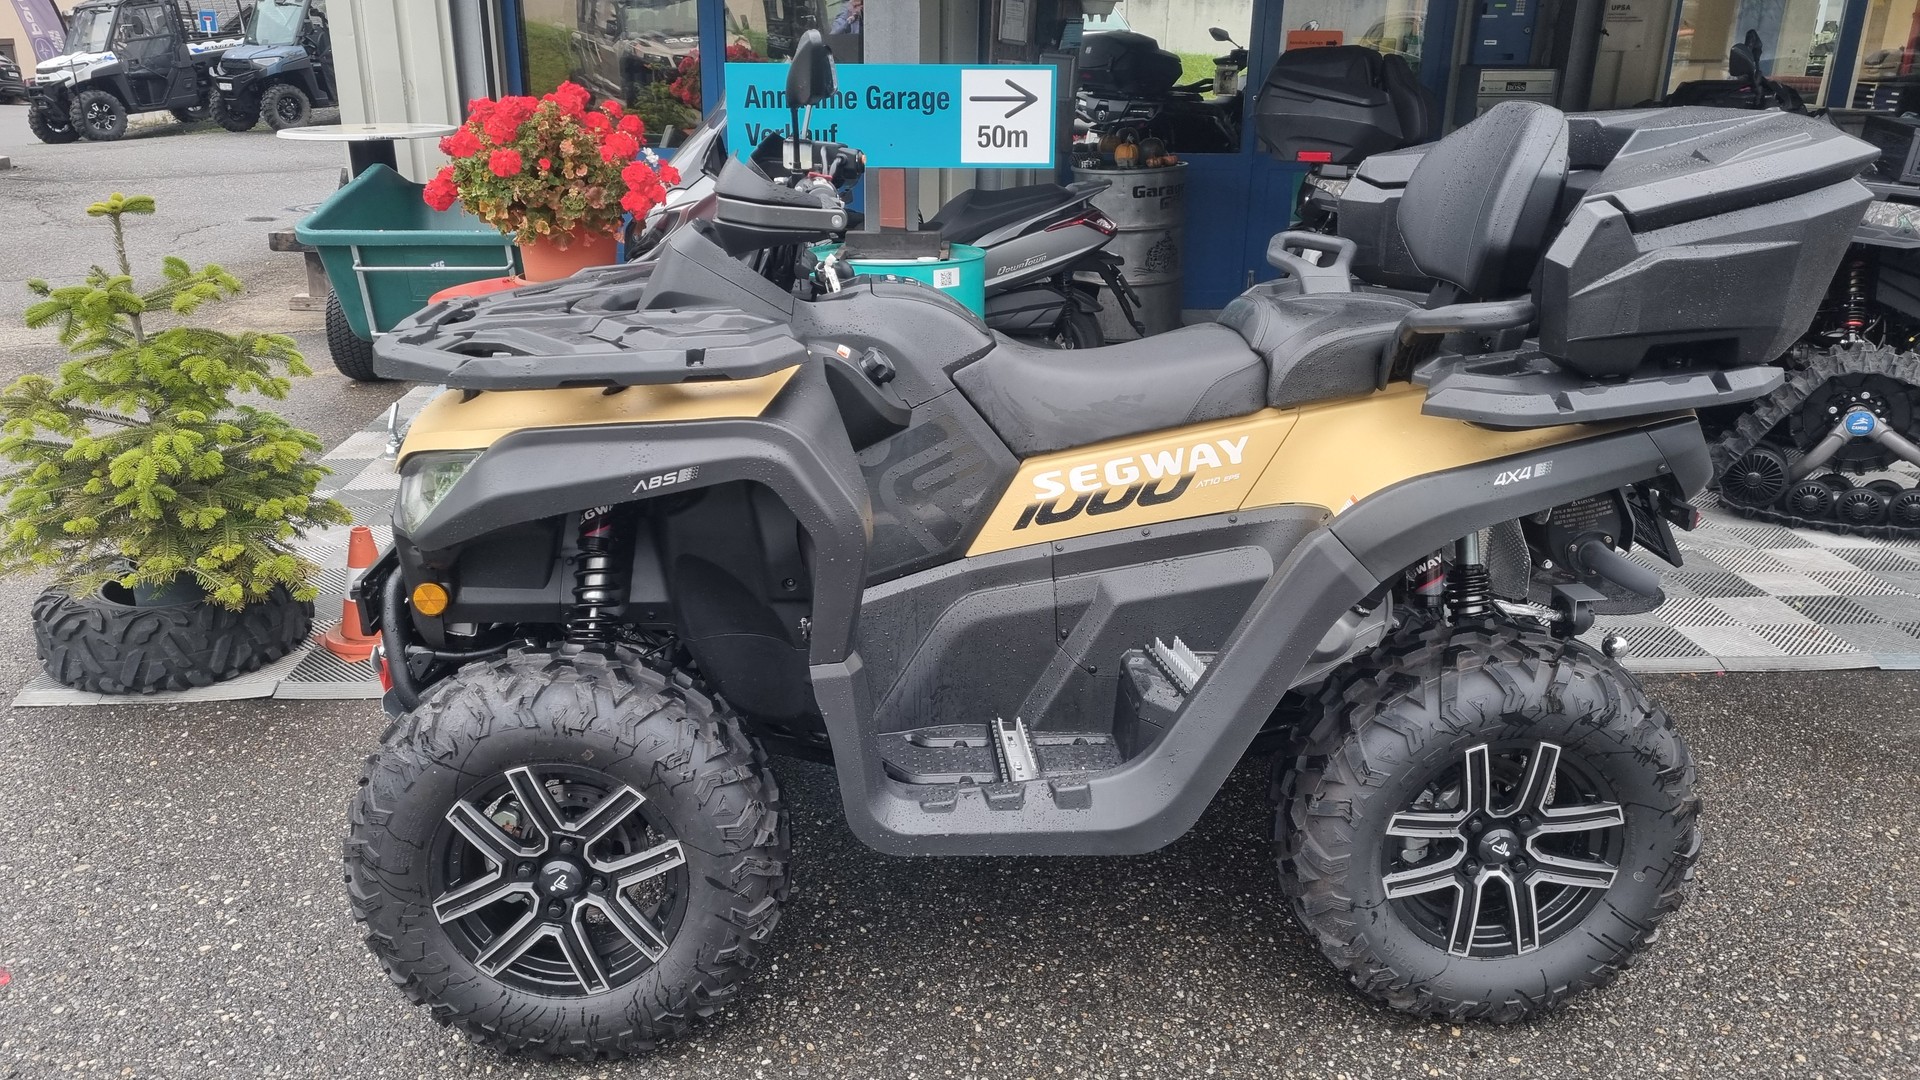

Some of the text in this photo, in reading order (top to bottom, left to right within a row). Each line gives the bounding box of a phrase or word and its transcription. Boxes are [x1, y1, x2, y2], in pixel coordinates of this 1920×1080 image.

[744, 84, 950, 115] Annme Garage
[977, 124, 1028, 148] 50m
[1032, 435, 1249, 500] SEGWAY
[1493, 466, 1532, 486] 4X4
[632, 471, 678, 494] ABS
[1012, 472, 1197, 531] 1000
